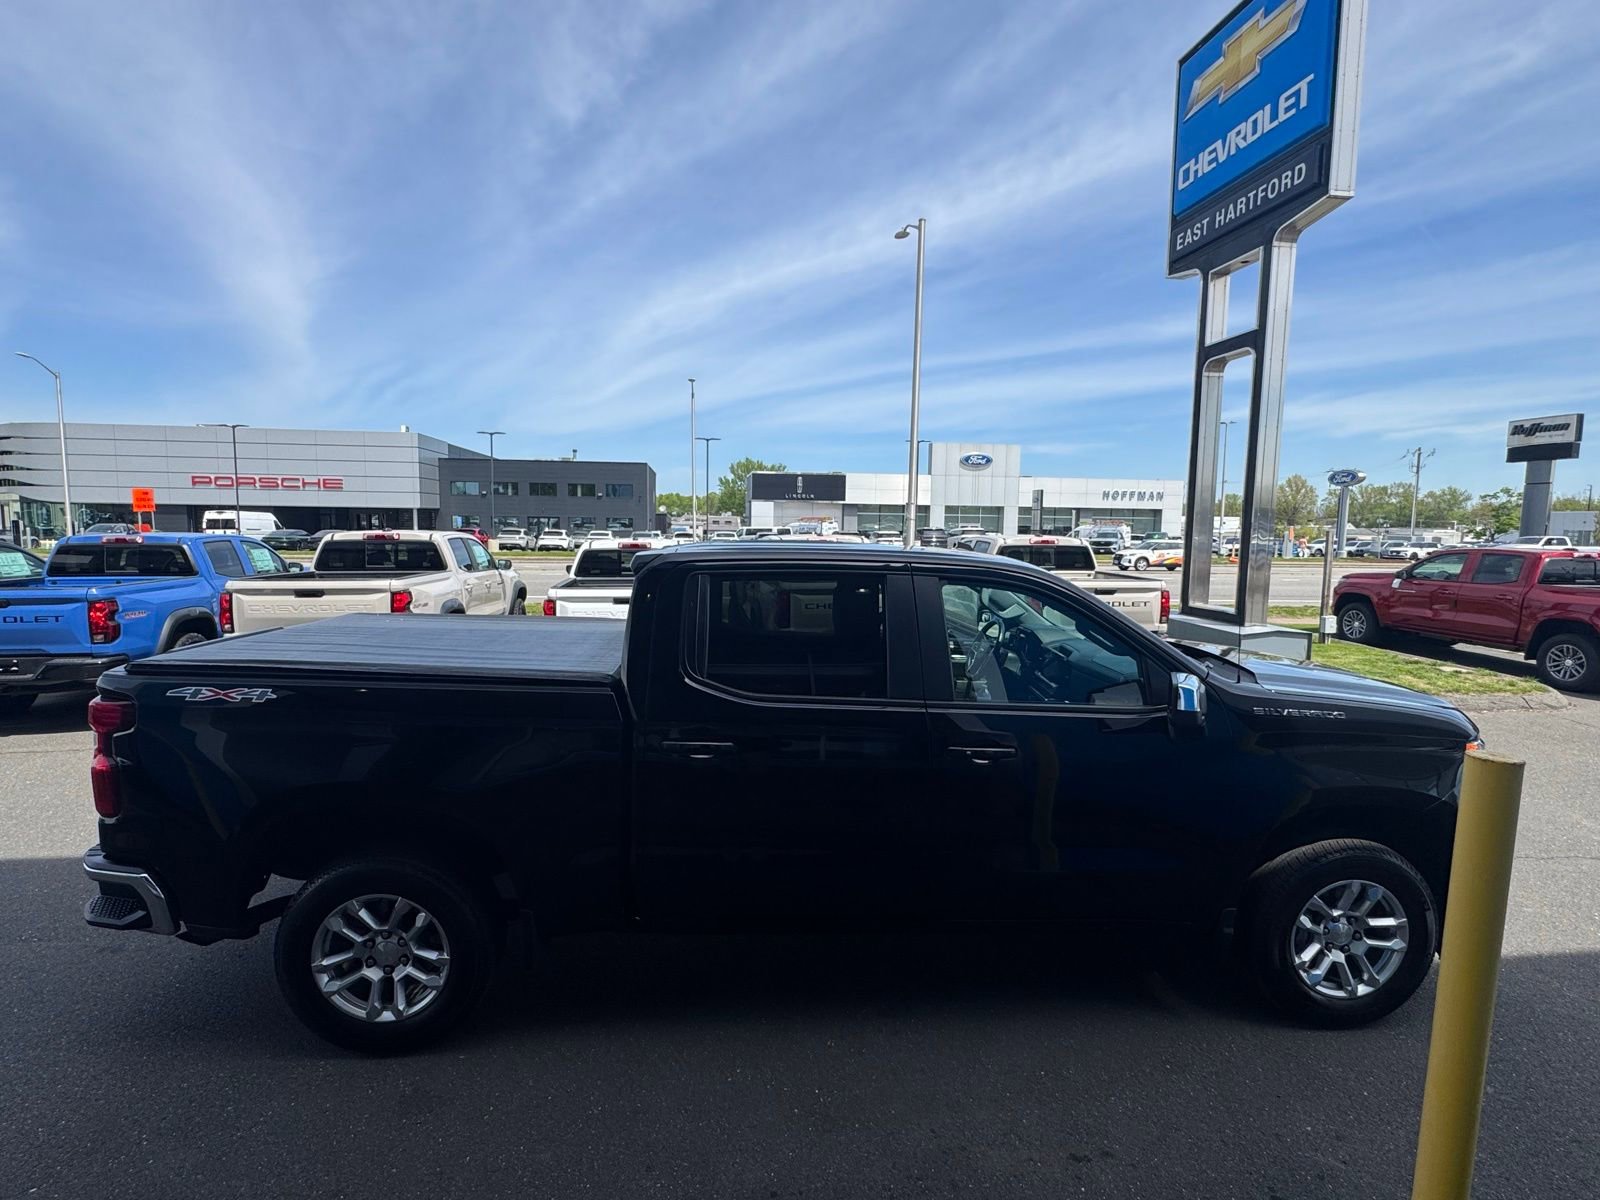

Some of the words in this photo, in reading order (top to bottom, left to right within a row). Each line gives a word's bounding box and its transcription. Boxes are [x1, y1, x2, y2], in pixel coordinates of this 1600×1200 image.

[1177, 73, 1314, 191] CHEVROLET
[1176, 217, 1210, 251] EAST
[1214, 162, 1307, 229] HARTFORD
[1510, 422, 1571, 437] Hoffman
[968, 455, 987, 465] Ford
[191, 475, 344, 489] PORSCHE
[1332, 472, 1353, 483] Ford
[1102, 490, 1164, 501] HOFFMAN
[248, 603, 373, 614] CHEVROLET
[1253, 706, 1346, 719] SILVERADO
